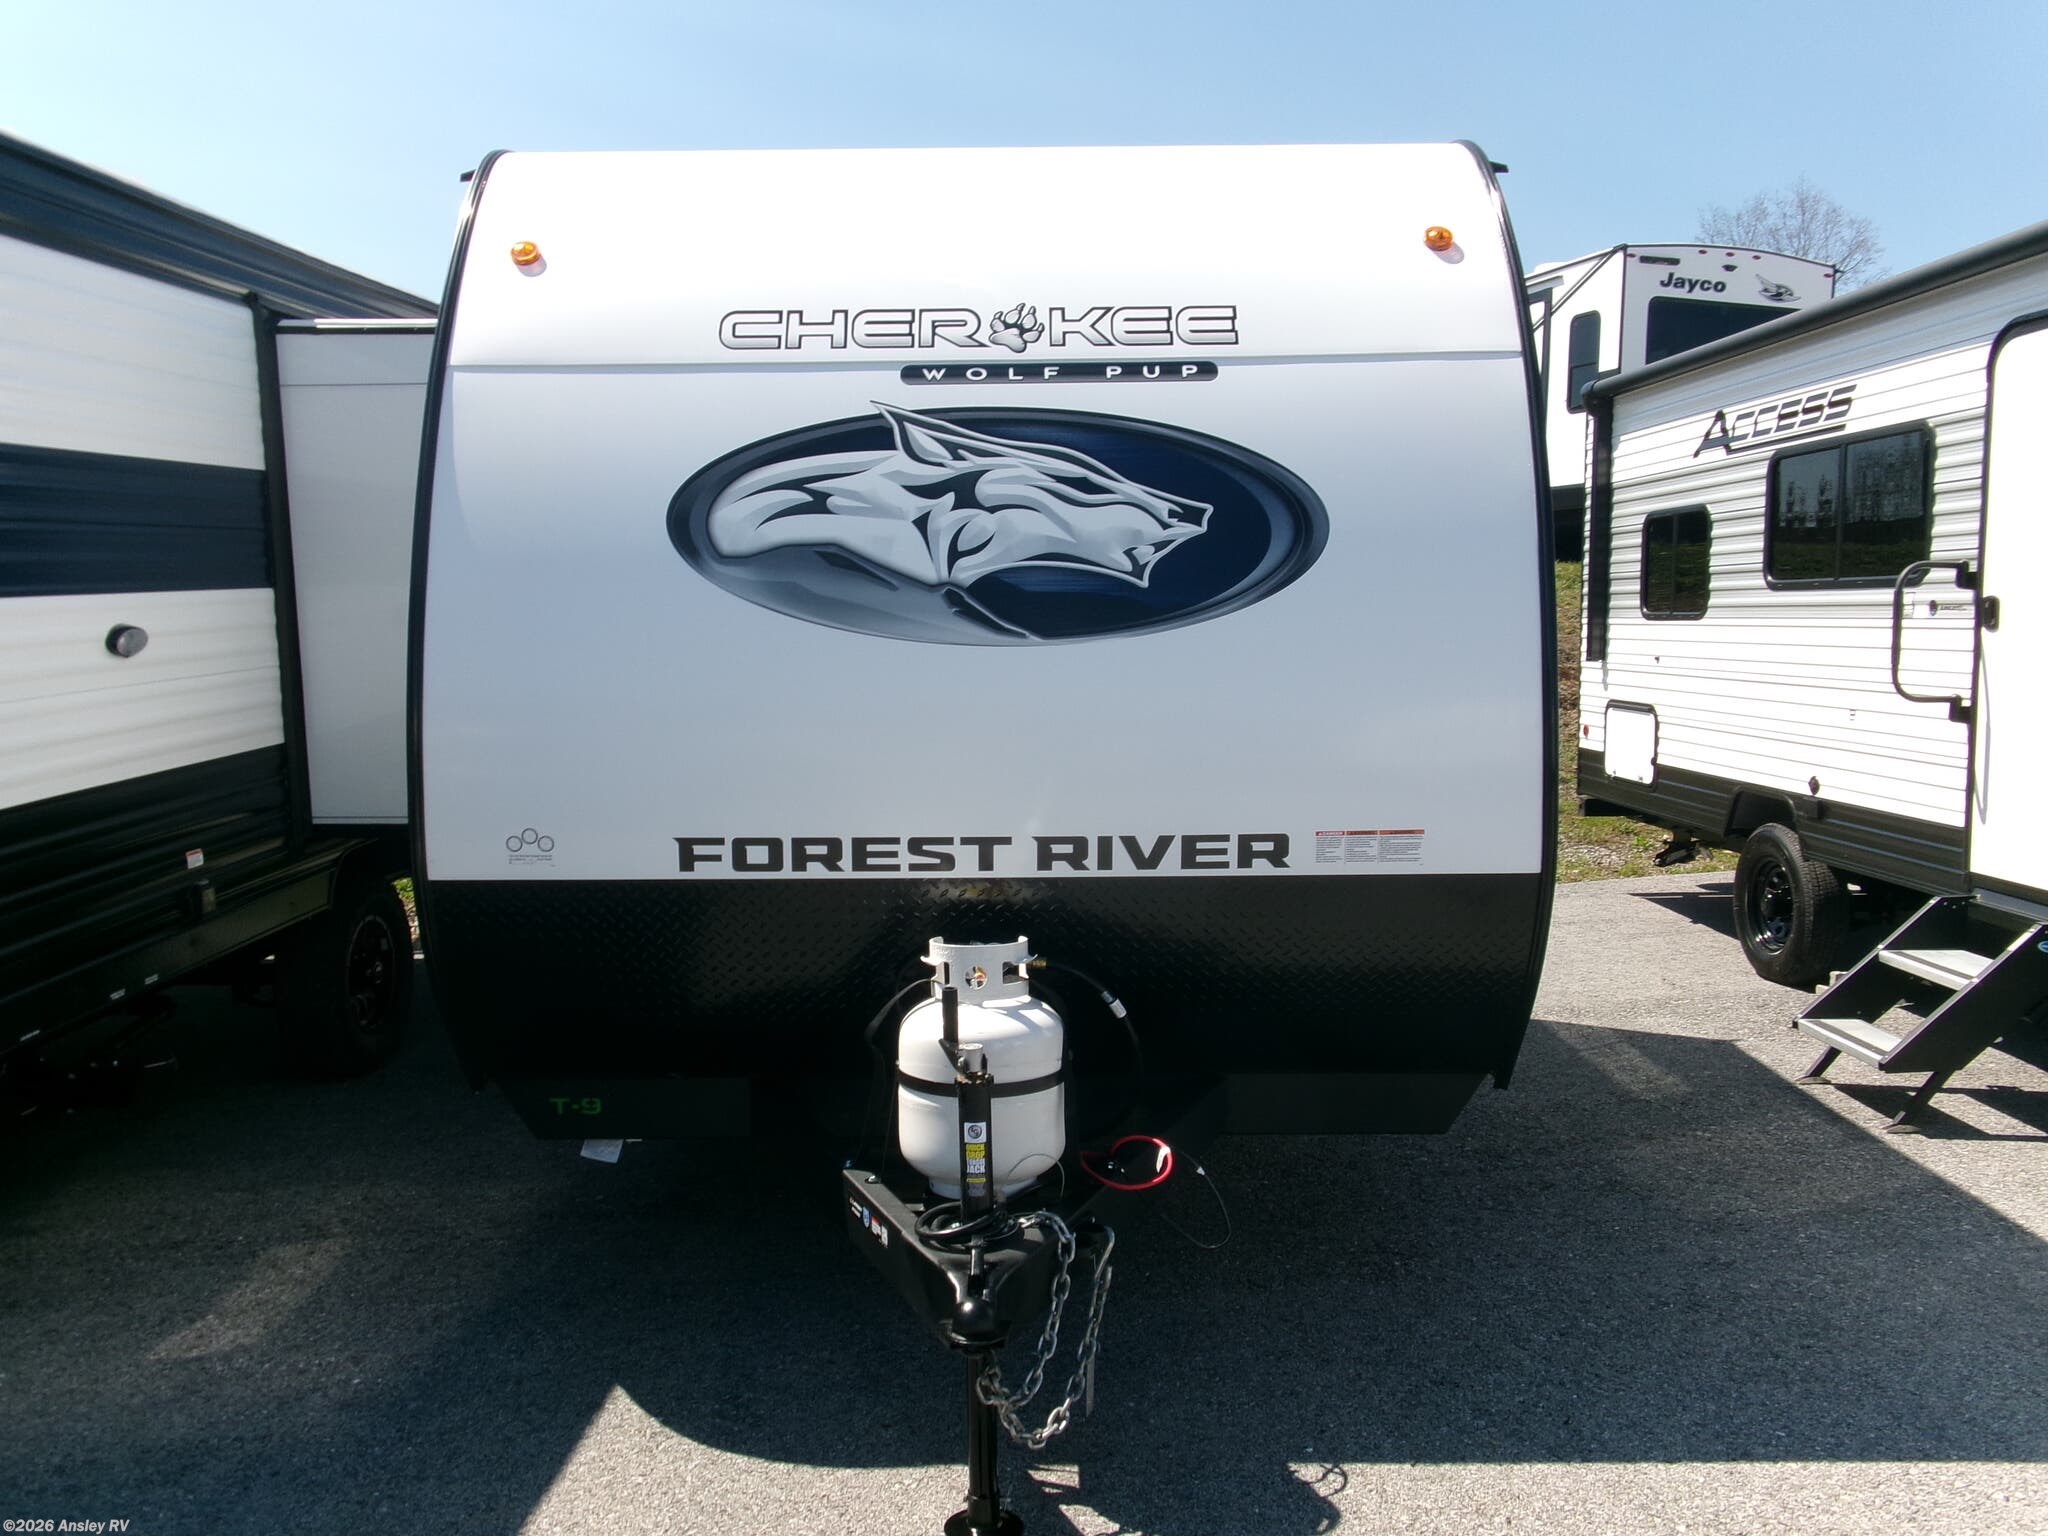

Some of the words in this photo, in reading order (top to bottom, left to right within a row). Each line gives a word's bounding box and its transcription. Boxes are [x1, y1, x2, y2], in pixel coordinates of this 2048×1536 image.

[1660, 272, 1727, 293] Jayco
[922, 366, 1060, 382] WOLF
[1106, 365, 1199, 379] PUP
[1693, 384, 1857, 458] ACCESS
[672, 836, 1013, 873] FOREST
[1031, 833, 1290, 872] RIVER
[549, 1098, 602, 1115] T-9
